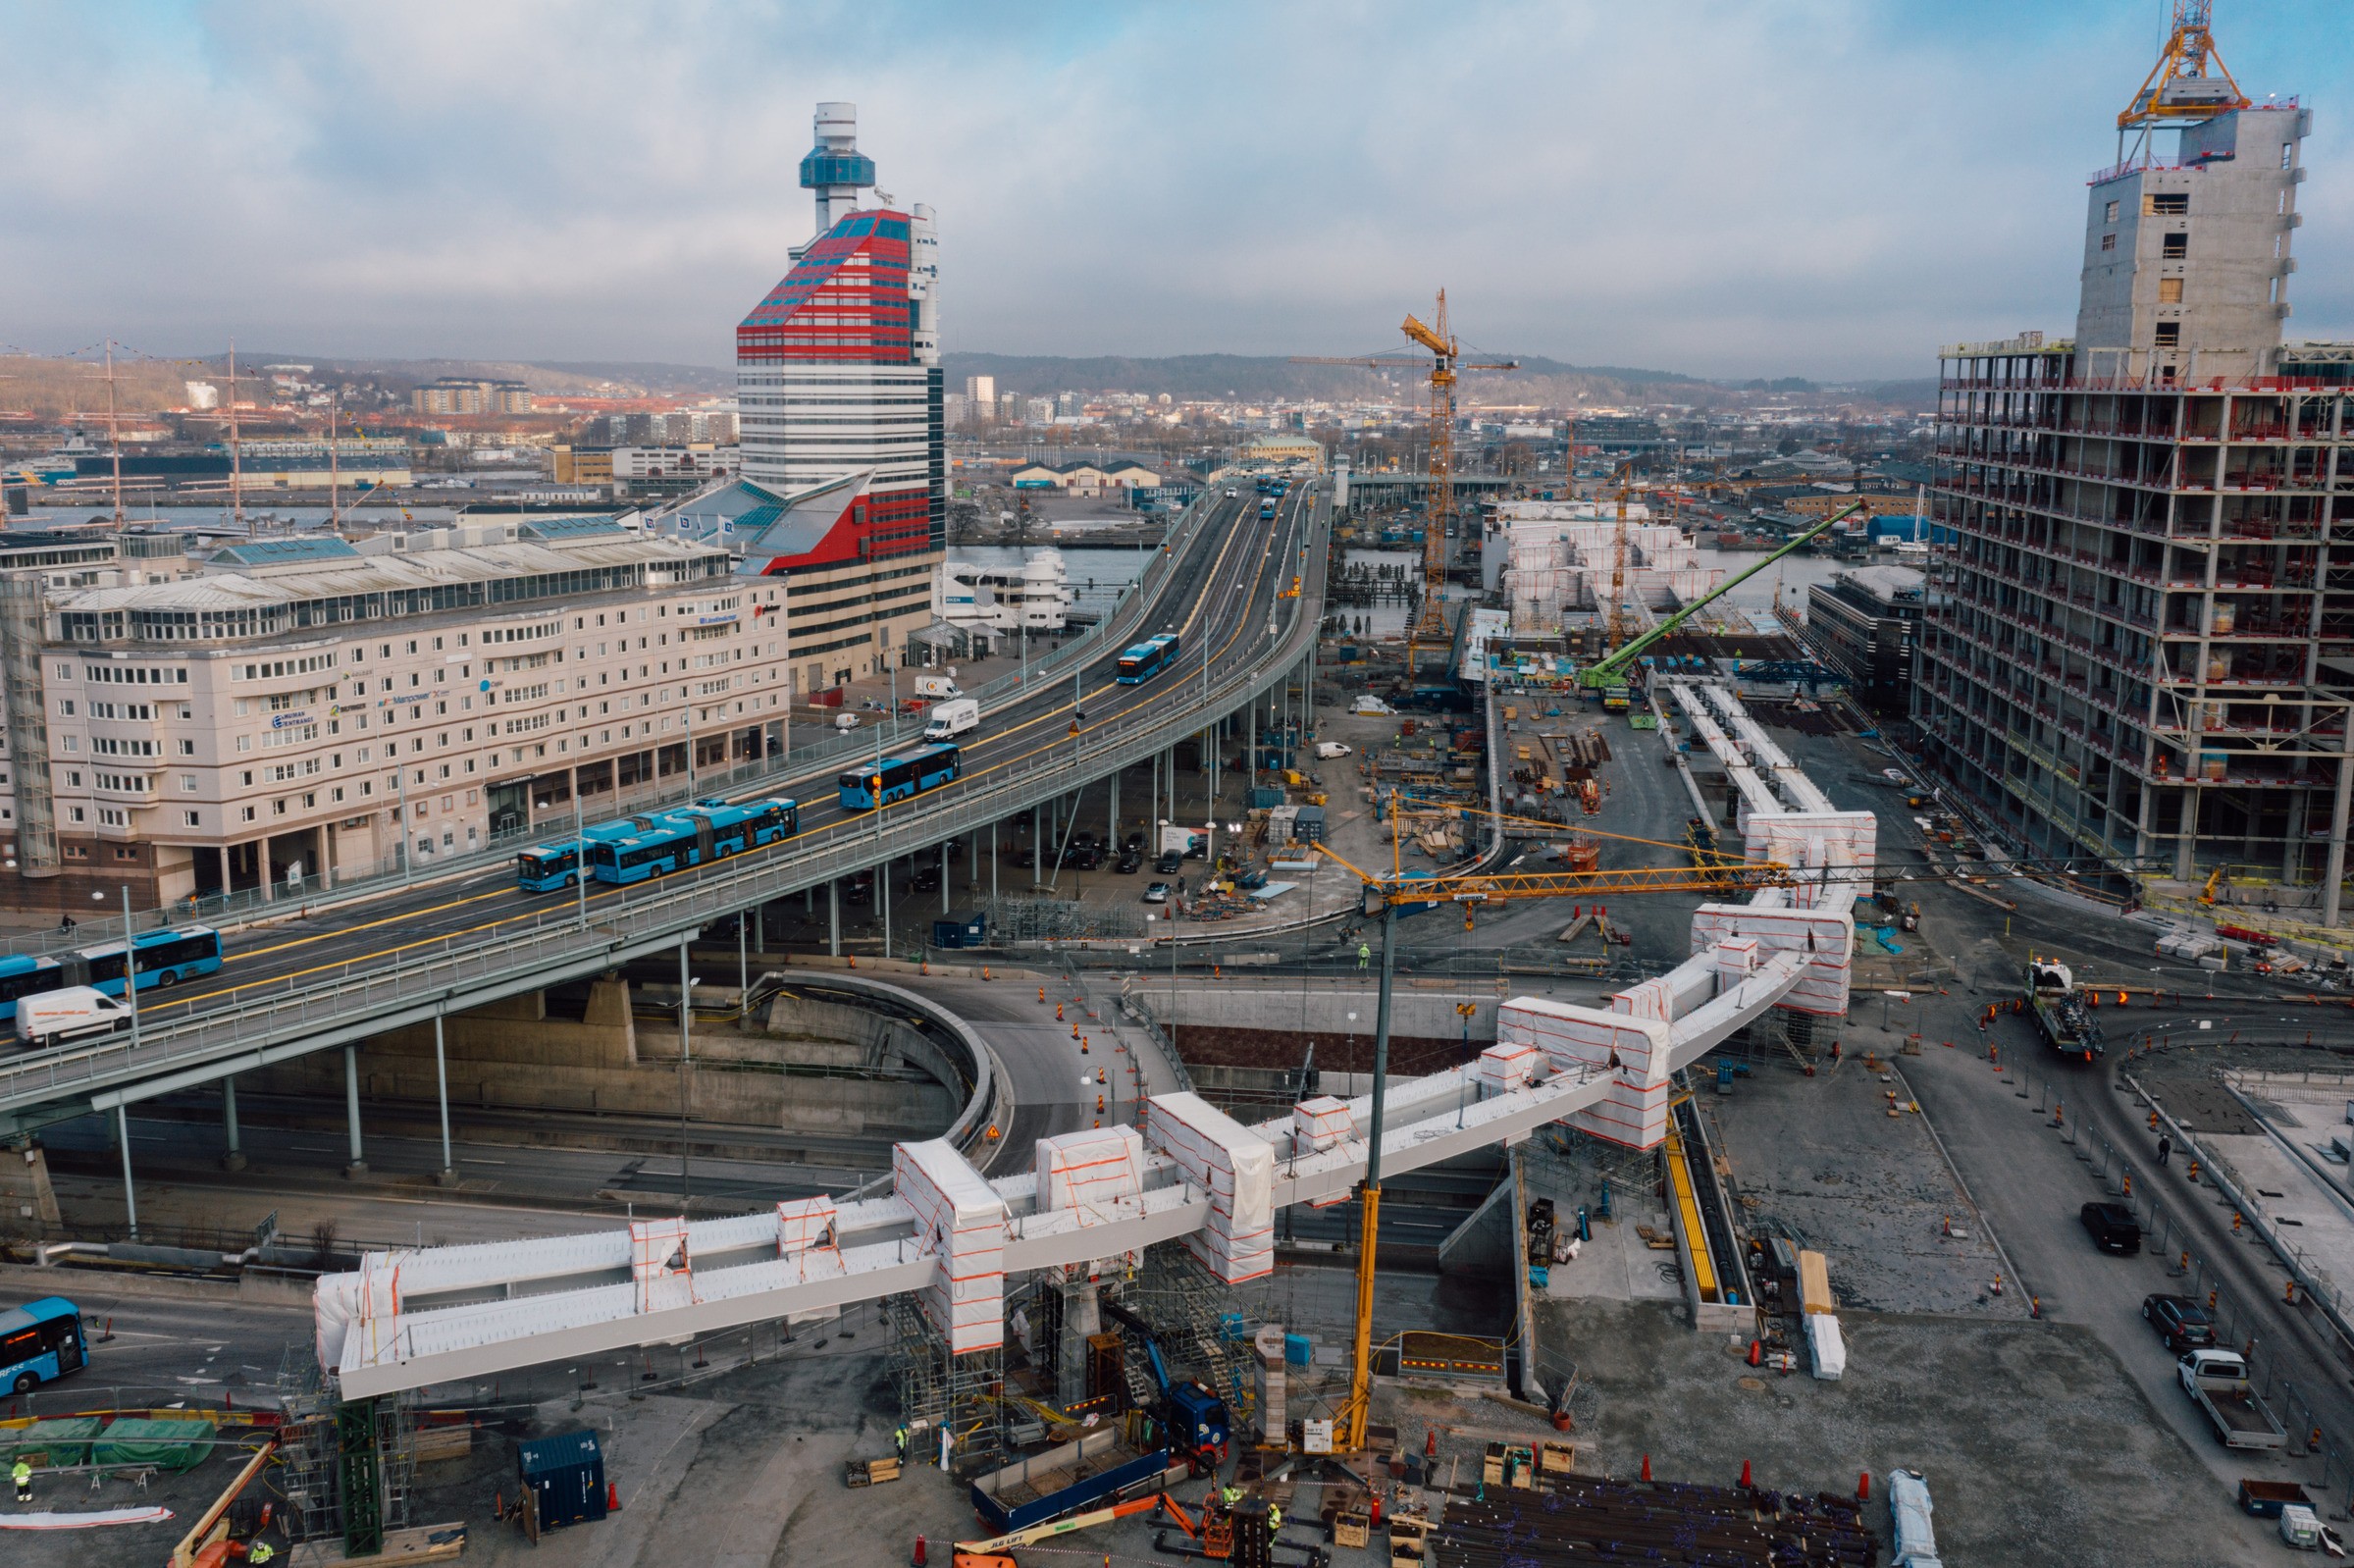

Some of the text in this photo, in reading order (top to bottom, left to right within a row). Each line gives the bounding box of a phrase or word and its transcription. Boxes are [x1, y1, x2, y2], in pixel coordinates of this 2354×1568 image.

[1893, 591, 1914, 601] NCC
[392, 691, 430, 705] Manpower
[284, 710, 305, 719] HUMAN
[990, 1535, 1023, 1548] JLG LIFT
